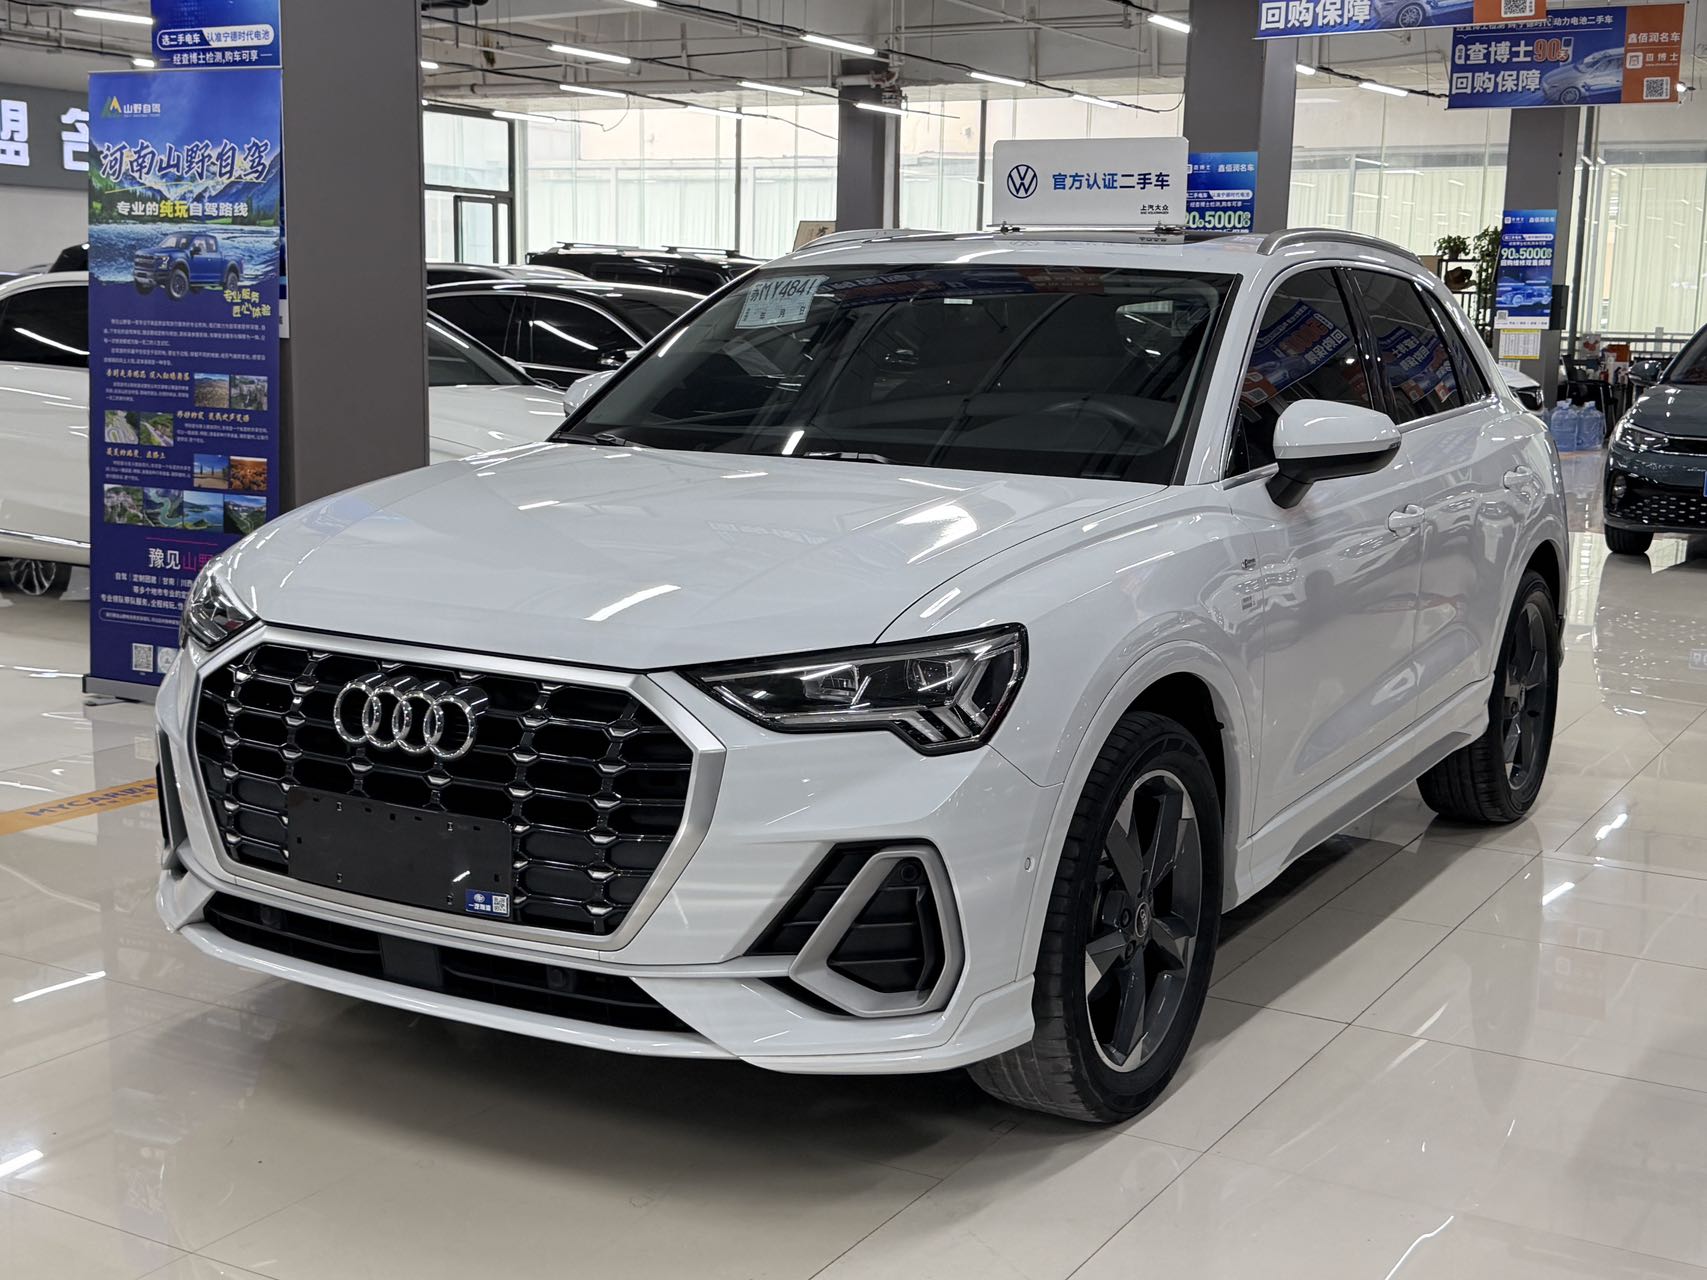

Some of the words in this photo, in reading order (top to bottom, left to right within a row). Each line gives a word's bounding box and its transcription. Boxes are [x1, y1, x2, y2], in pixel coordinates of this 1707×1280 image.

[1261, 0, 1371, 30] 回购保障
[1553, 15, 1614, 26] 动力电池二手车
[1451, 70, 1541, 95] 回购保障
[124, 103, 161, 114] 山野自驾
[100, 136, 271, 183] 河南山野自驾
[1051, 171, 1170, 191] 官方认证二手车
[116, 200, 249, 218] 专业的纯玩自驾路线
